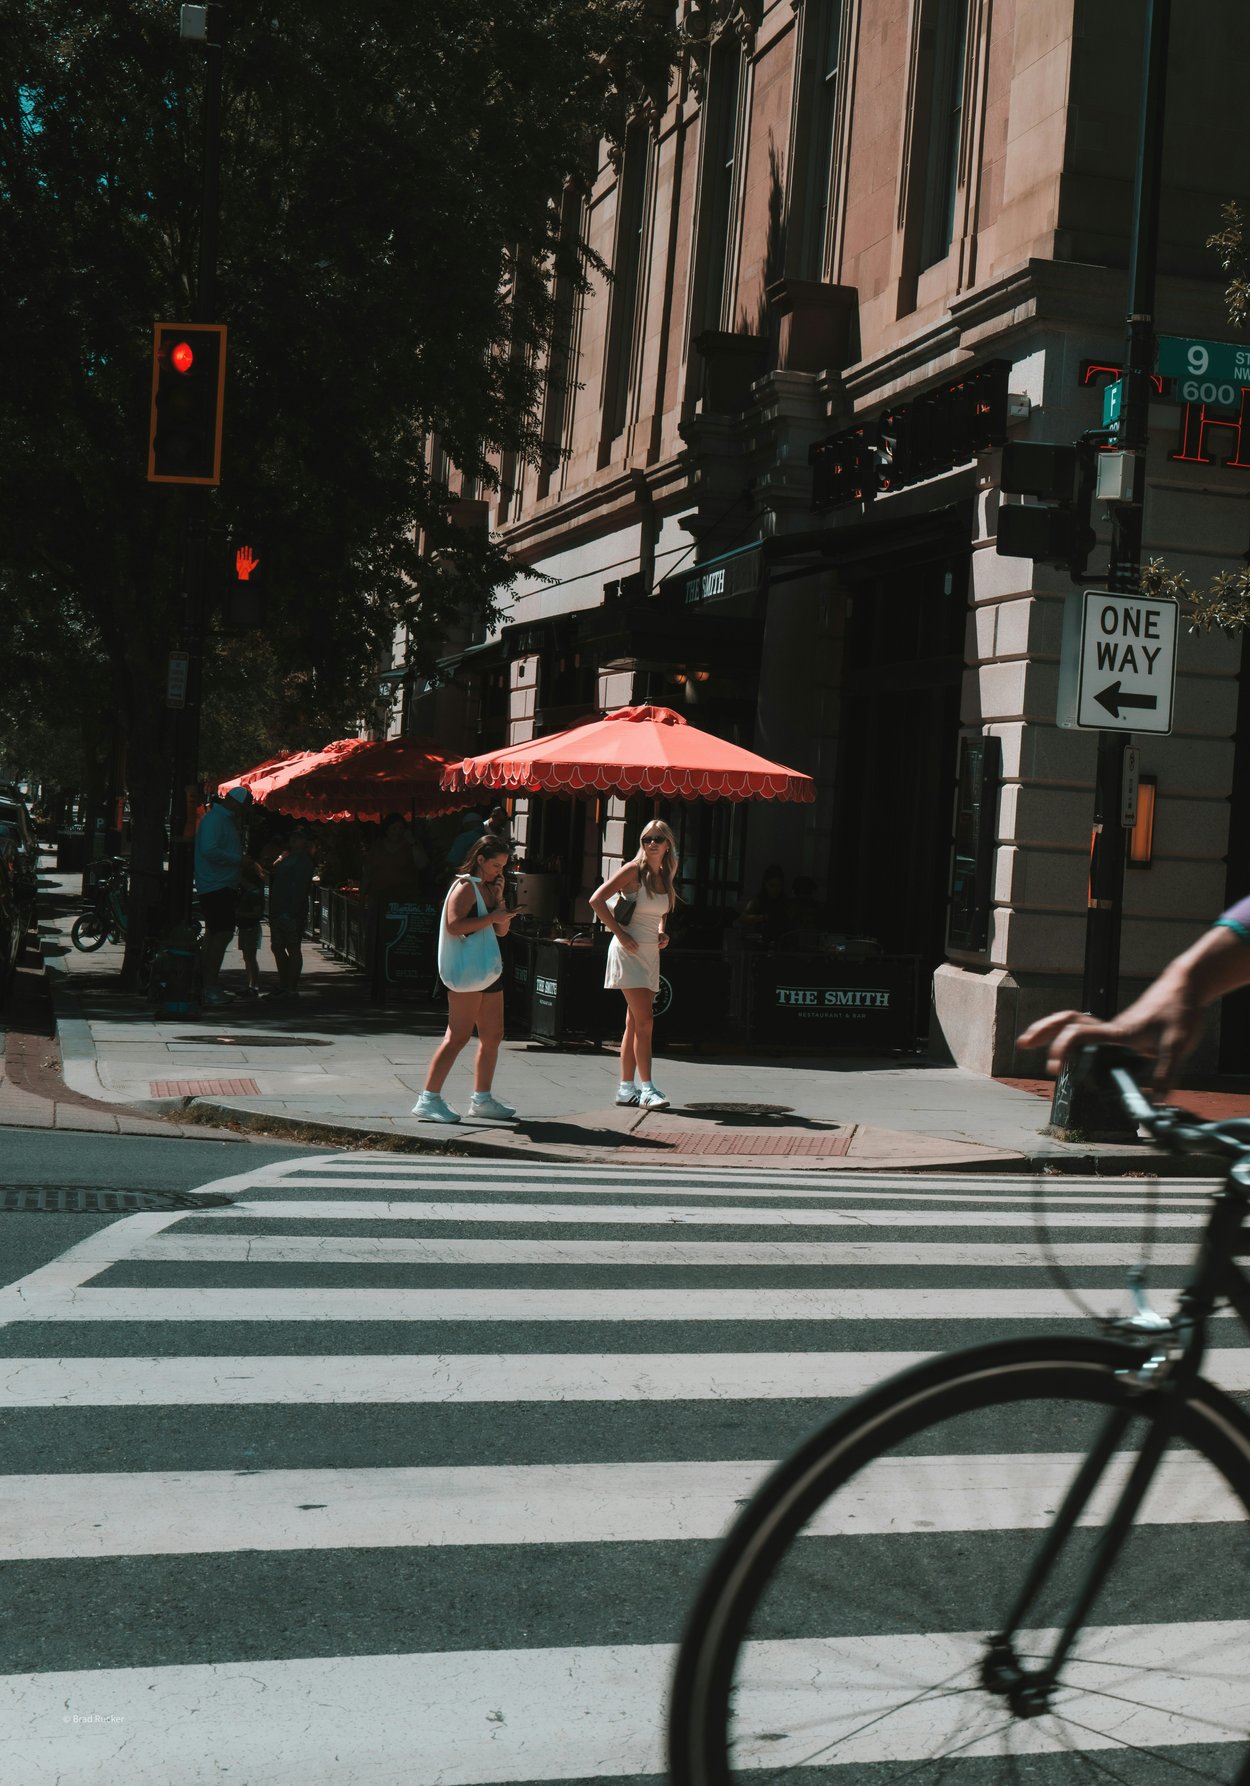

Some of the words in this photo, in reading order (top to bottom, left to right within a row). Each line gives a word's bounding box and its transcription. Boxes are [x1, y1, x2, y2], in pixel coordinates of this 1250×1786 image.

[1187, 345, 1209, 375] 9
[1110, 388, 1118, 417] F
[1182, 381, 1235, 405] 600
[702, 569, 725, 598] SMITH
[1100, 605, 1161, 639] ONE
[1097, 641, 1162, 675] WAY
[775, 989, 818, 1005] THE
[824, 991, 890, 1007] SMITH
